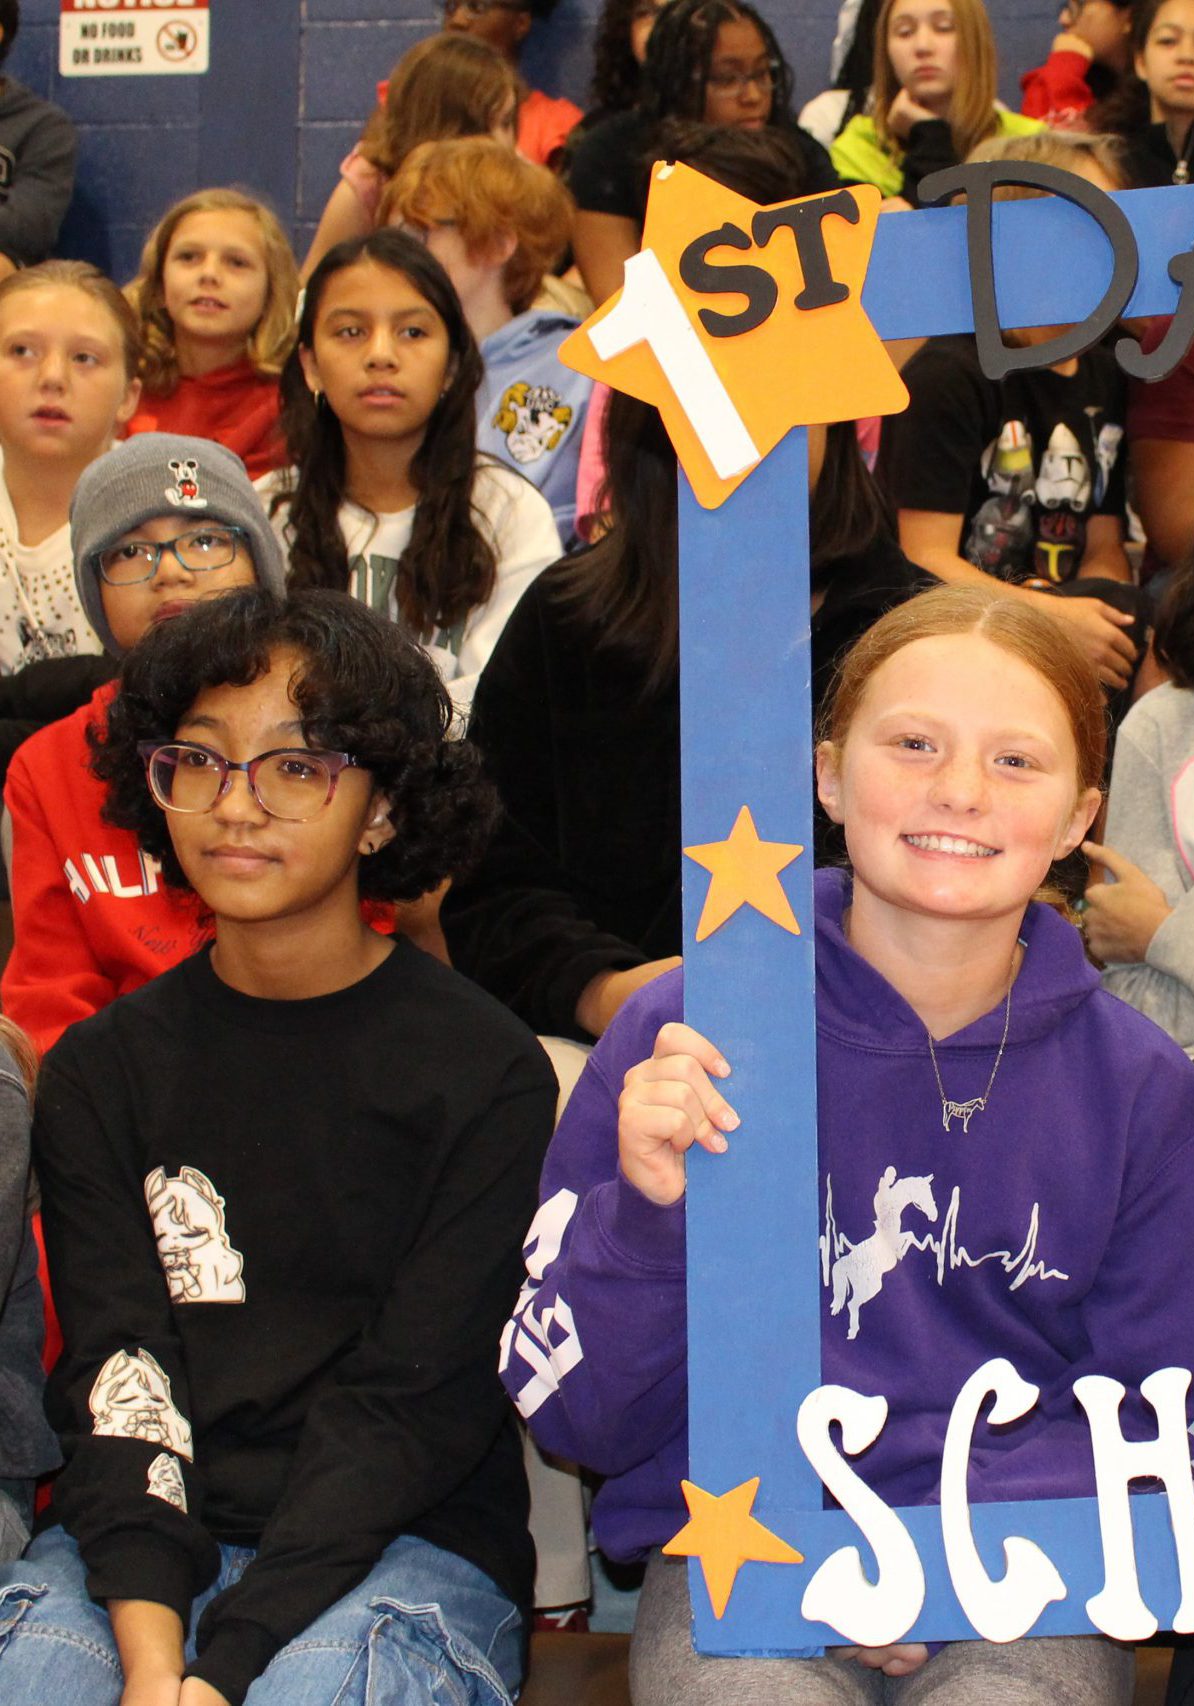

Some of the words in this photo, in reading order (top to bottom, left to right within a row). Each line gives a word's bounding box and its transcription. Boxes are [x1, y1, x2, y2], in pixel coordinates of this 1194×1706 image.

[81, 23, 98, 38] NO
[102, 22, 135, 38] FOOD
[72, 48, 90, 64] OR
[94, 47, 143, 63] DRINKS
